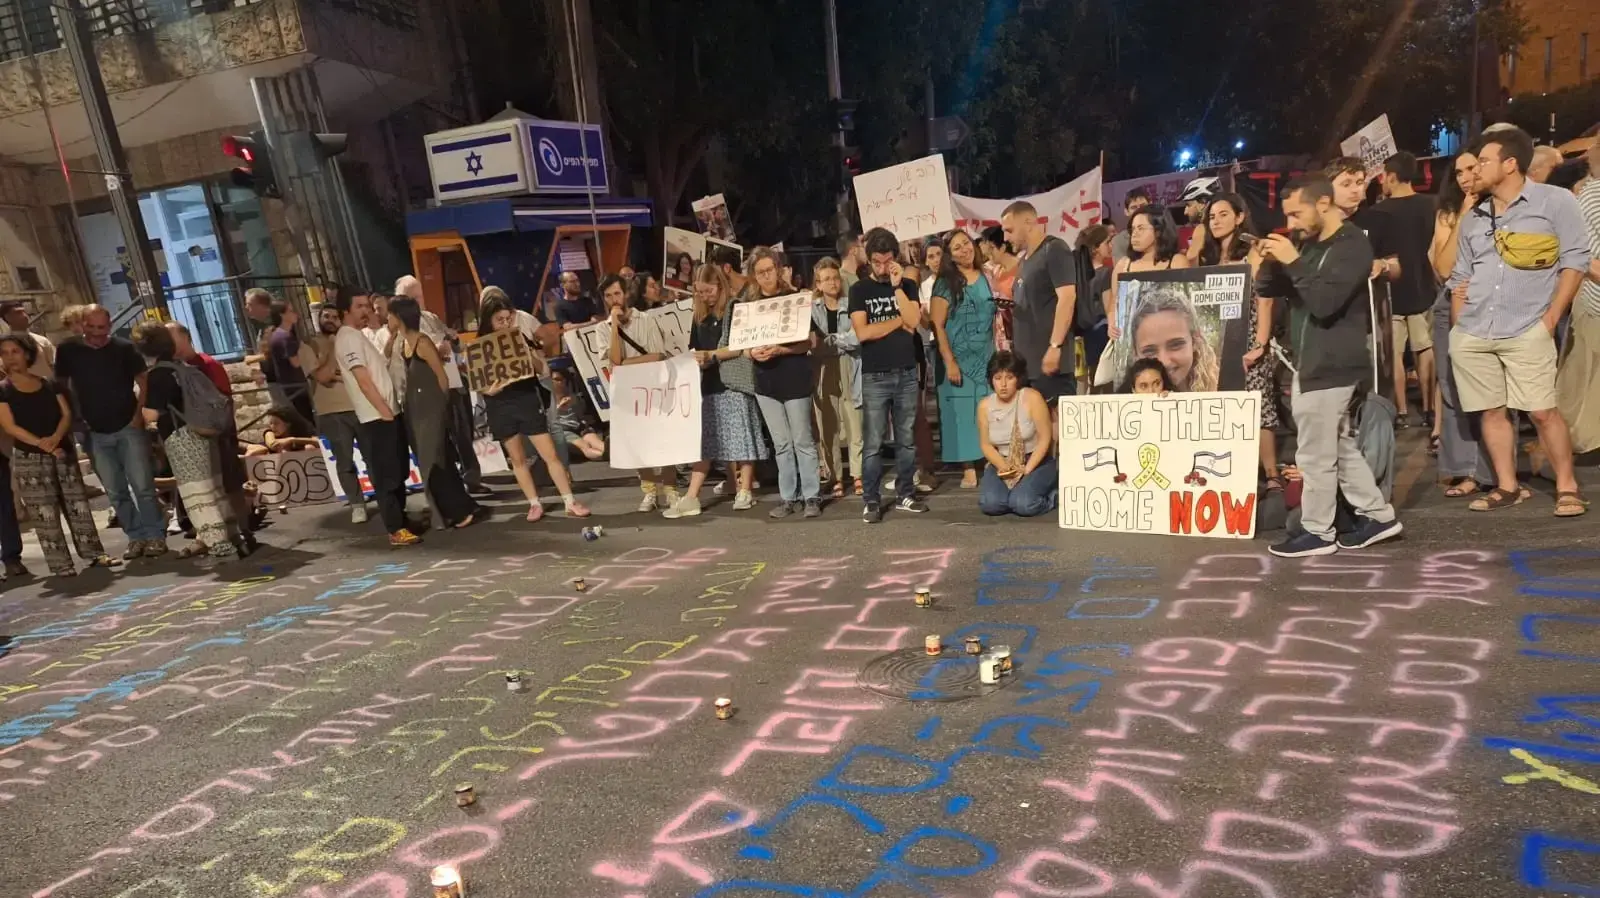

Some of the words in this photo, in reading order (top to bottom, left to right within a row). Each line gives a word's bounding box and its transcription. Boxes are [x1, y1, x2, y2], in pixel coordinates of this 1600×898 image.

[563, 157, 581, 167] הפיס
[1194, 293, 1214, 303] ROMI
[1215, 291, 1240, 302] GONEN
[1208, 277, 1223, 288] גונן
[1226, 276, 1243, 286] רומי
[466, 333, 527, 364] FREE
[469, 356, 534, 390] HERSH
[631, 378, 692, 418] סליחה
[1152, 397, 1256, 441] THEM
[252, 455, 337, 505] SOS
[1063, 486, 1154, 531] HOME
[1169, 489, 1256, 536] NOW
